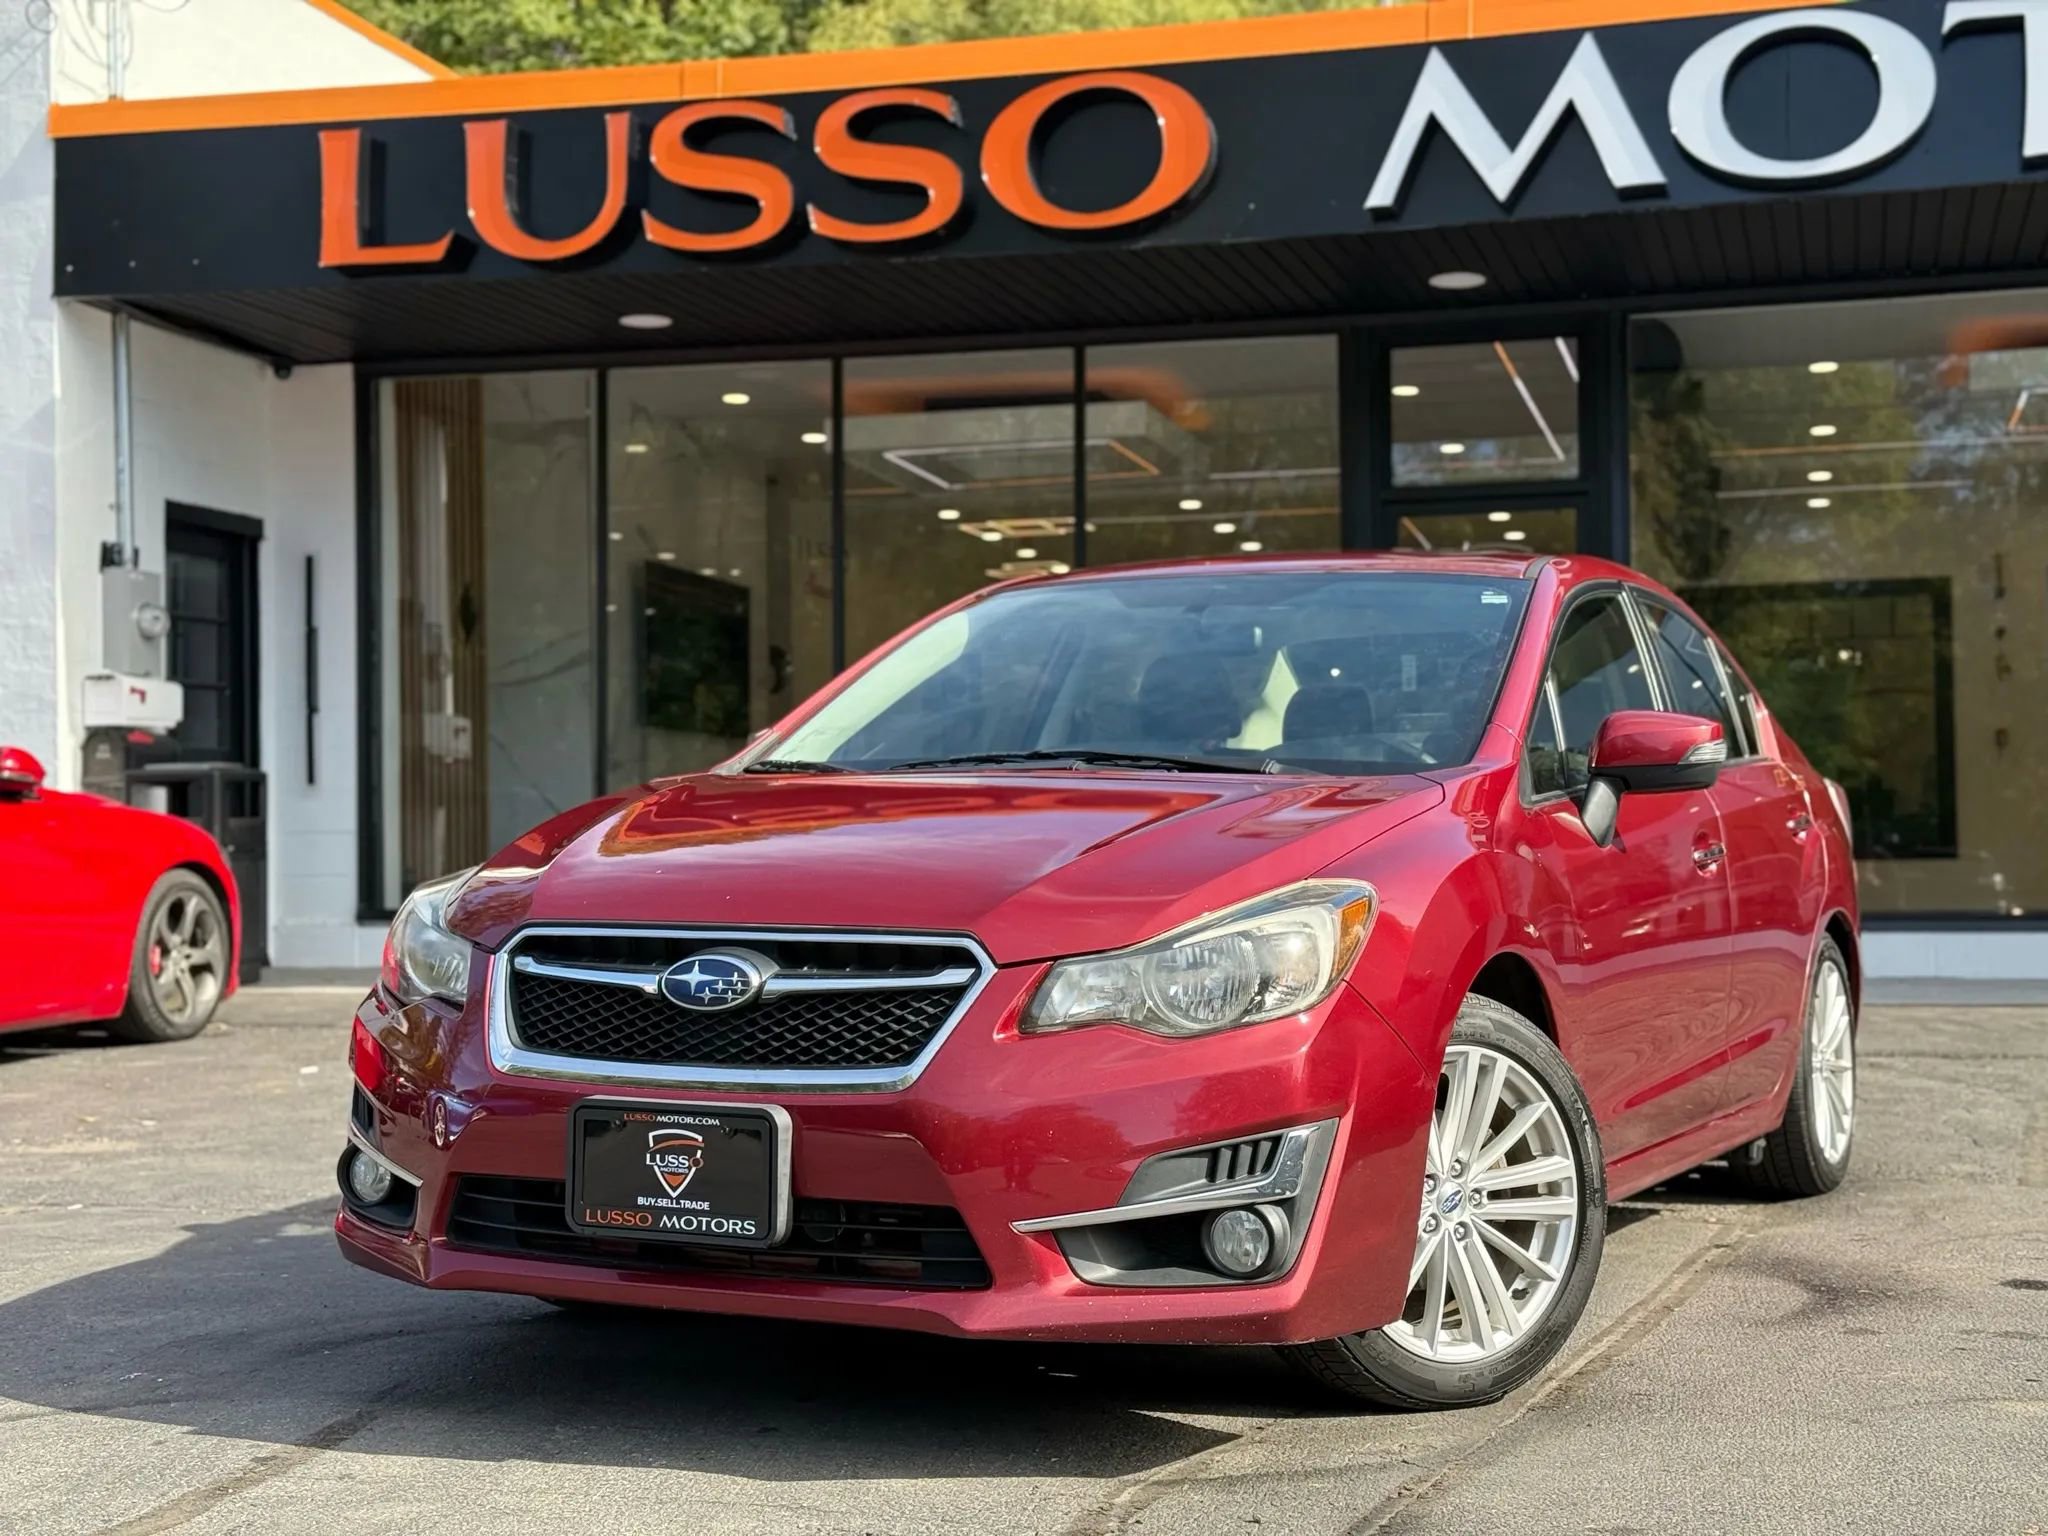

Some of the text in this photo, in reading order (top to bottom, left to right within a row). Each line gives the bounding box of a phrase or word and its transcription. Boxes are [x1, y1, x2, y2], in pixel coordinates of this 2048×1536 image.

[318, 71, 1217, 268] LUSSO
[646, 1153, 704, 1168] LUSSO
[660, 1166, 689, 1174] MOTORS
[585, 1209, 756, 1235] LUSSO MOTORS
